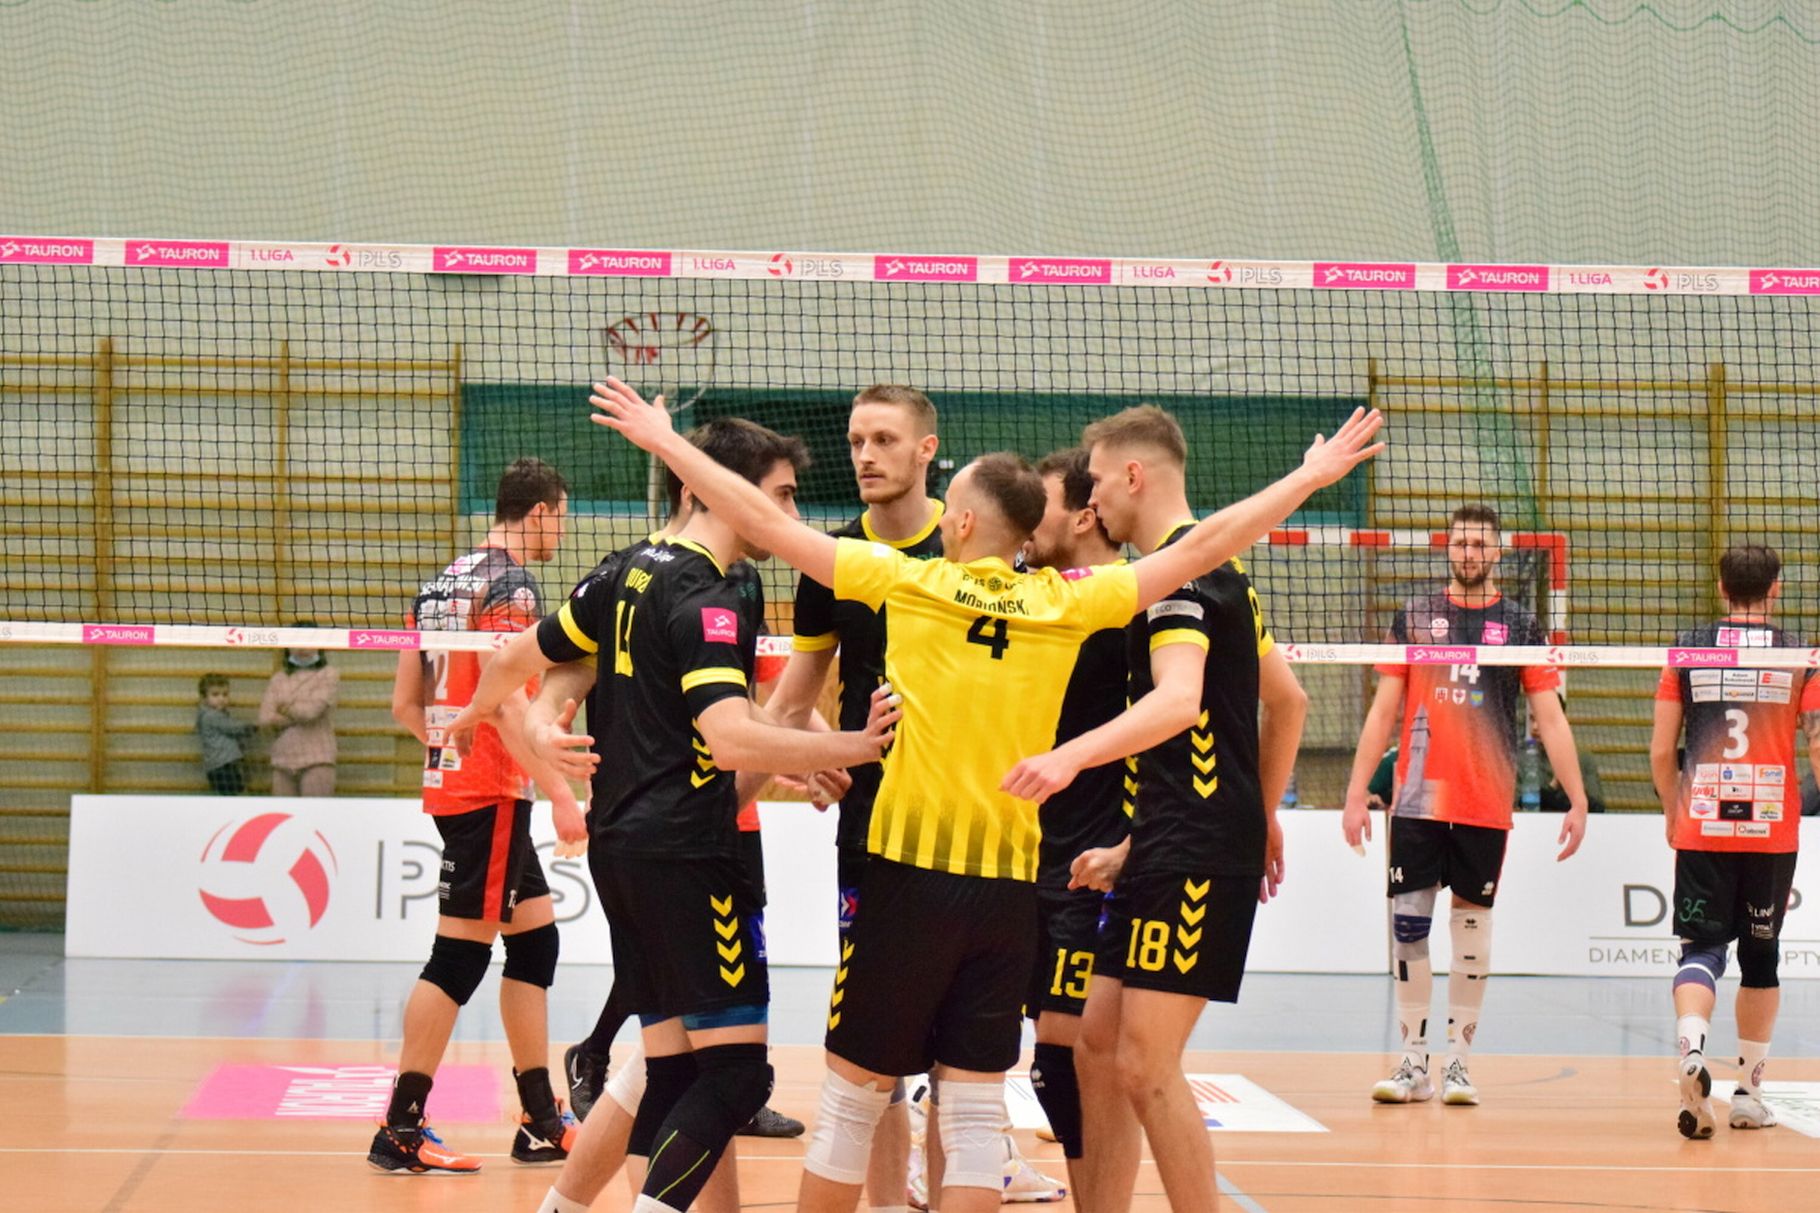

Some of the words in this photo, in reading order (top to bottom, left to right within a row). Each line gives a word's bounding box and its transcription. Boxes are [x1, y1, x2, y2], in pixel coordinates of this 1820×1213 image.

[23, 244, 84, 257] TAURON
[159, 248, 219, 260] TAURON
[359, 250, 401, 268] PLS
[467, 253, 527, 267] TAURON
[600, 256, 662, 269] TAURON
[801, 260, 843, 277] PLS
[907, 262, 967, 275] TAURON
[1041, 264, 1102, 278] TAURON
[1345, 269, 1406, 282] TAURON
[1241, 268, 1282, 284] PLS
[1479, 271, 1540, 285] TAURON
[1677, 274, 1719, 291] PLS
[105, 630, 149, 641] TAURON
[372, 634, 414, 647] TAURON
[967, 615, 1009, 660] 4
[1429, 650, 1471, 661] TAURON
[1690, 653, 1732, 664] TAURON
[1450, 664, 1481, 685] 14
[1722, 708, 1750, 760] 3
[1390, 866, 1404, 884] 14
[1126, 918, 1170, 971] 18
[1589, 948, 1682, 964] DIAMEN
[1050, 948, 1094, 998] 13
